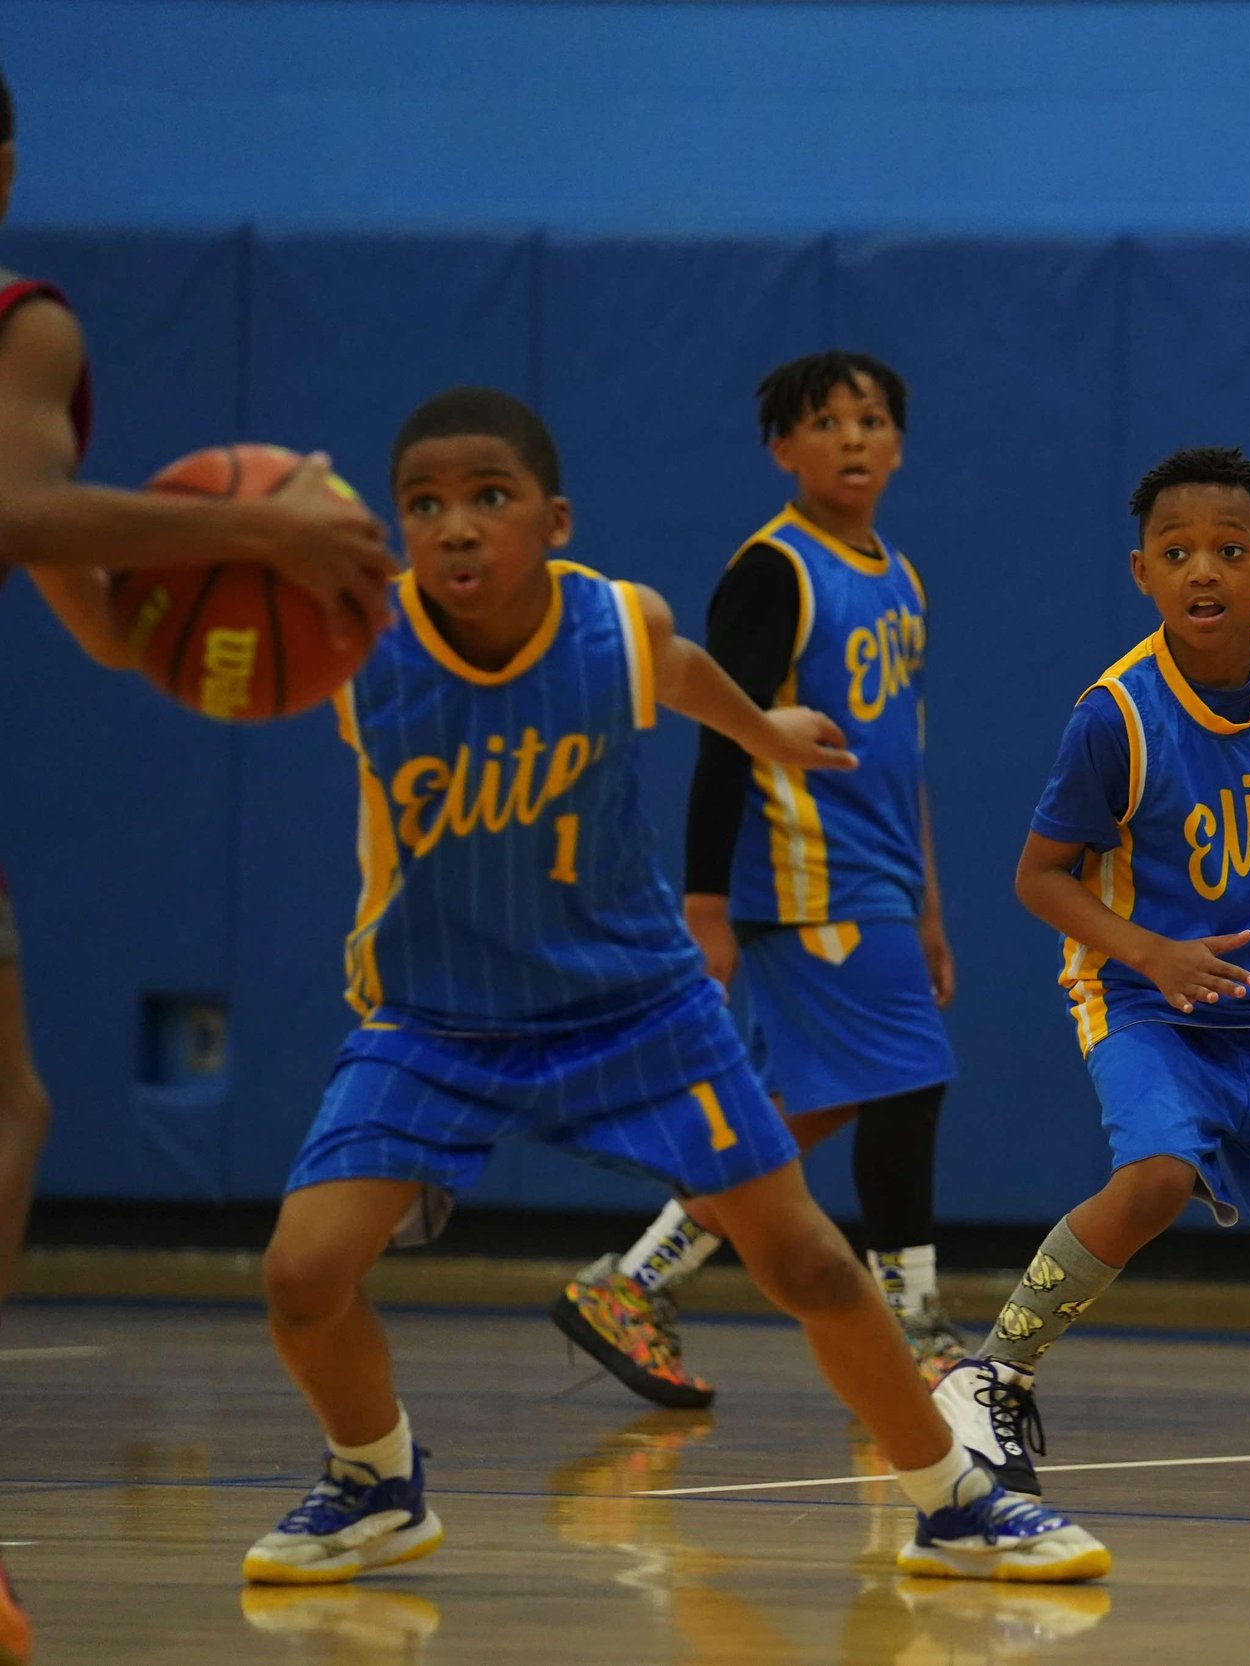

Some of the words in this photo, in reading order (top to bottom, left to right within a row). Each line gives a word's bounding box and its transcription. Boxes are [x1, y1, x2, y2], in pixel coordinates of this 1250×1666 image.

[391, 726, 598, 859] Elite
[548, 814, 579, 885] 1
[689, 1080, 738, 1152] 1
